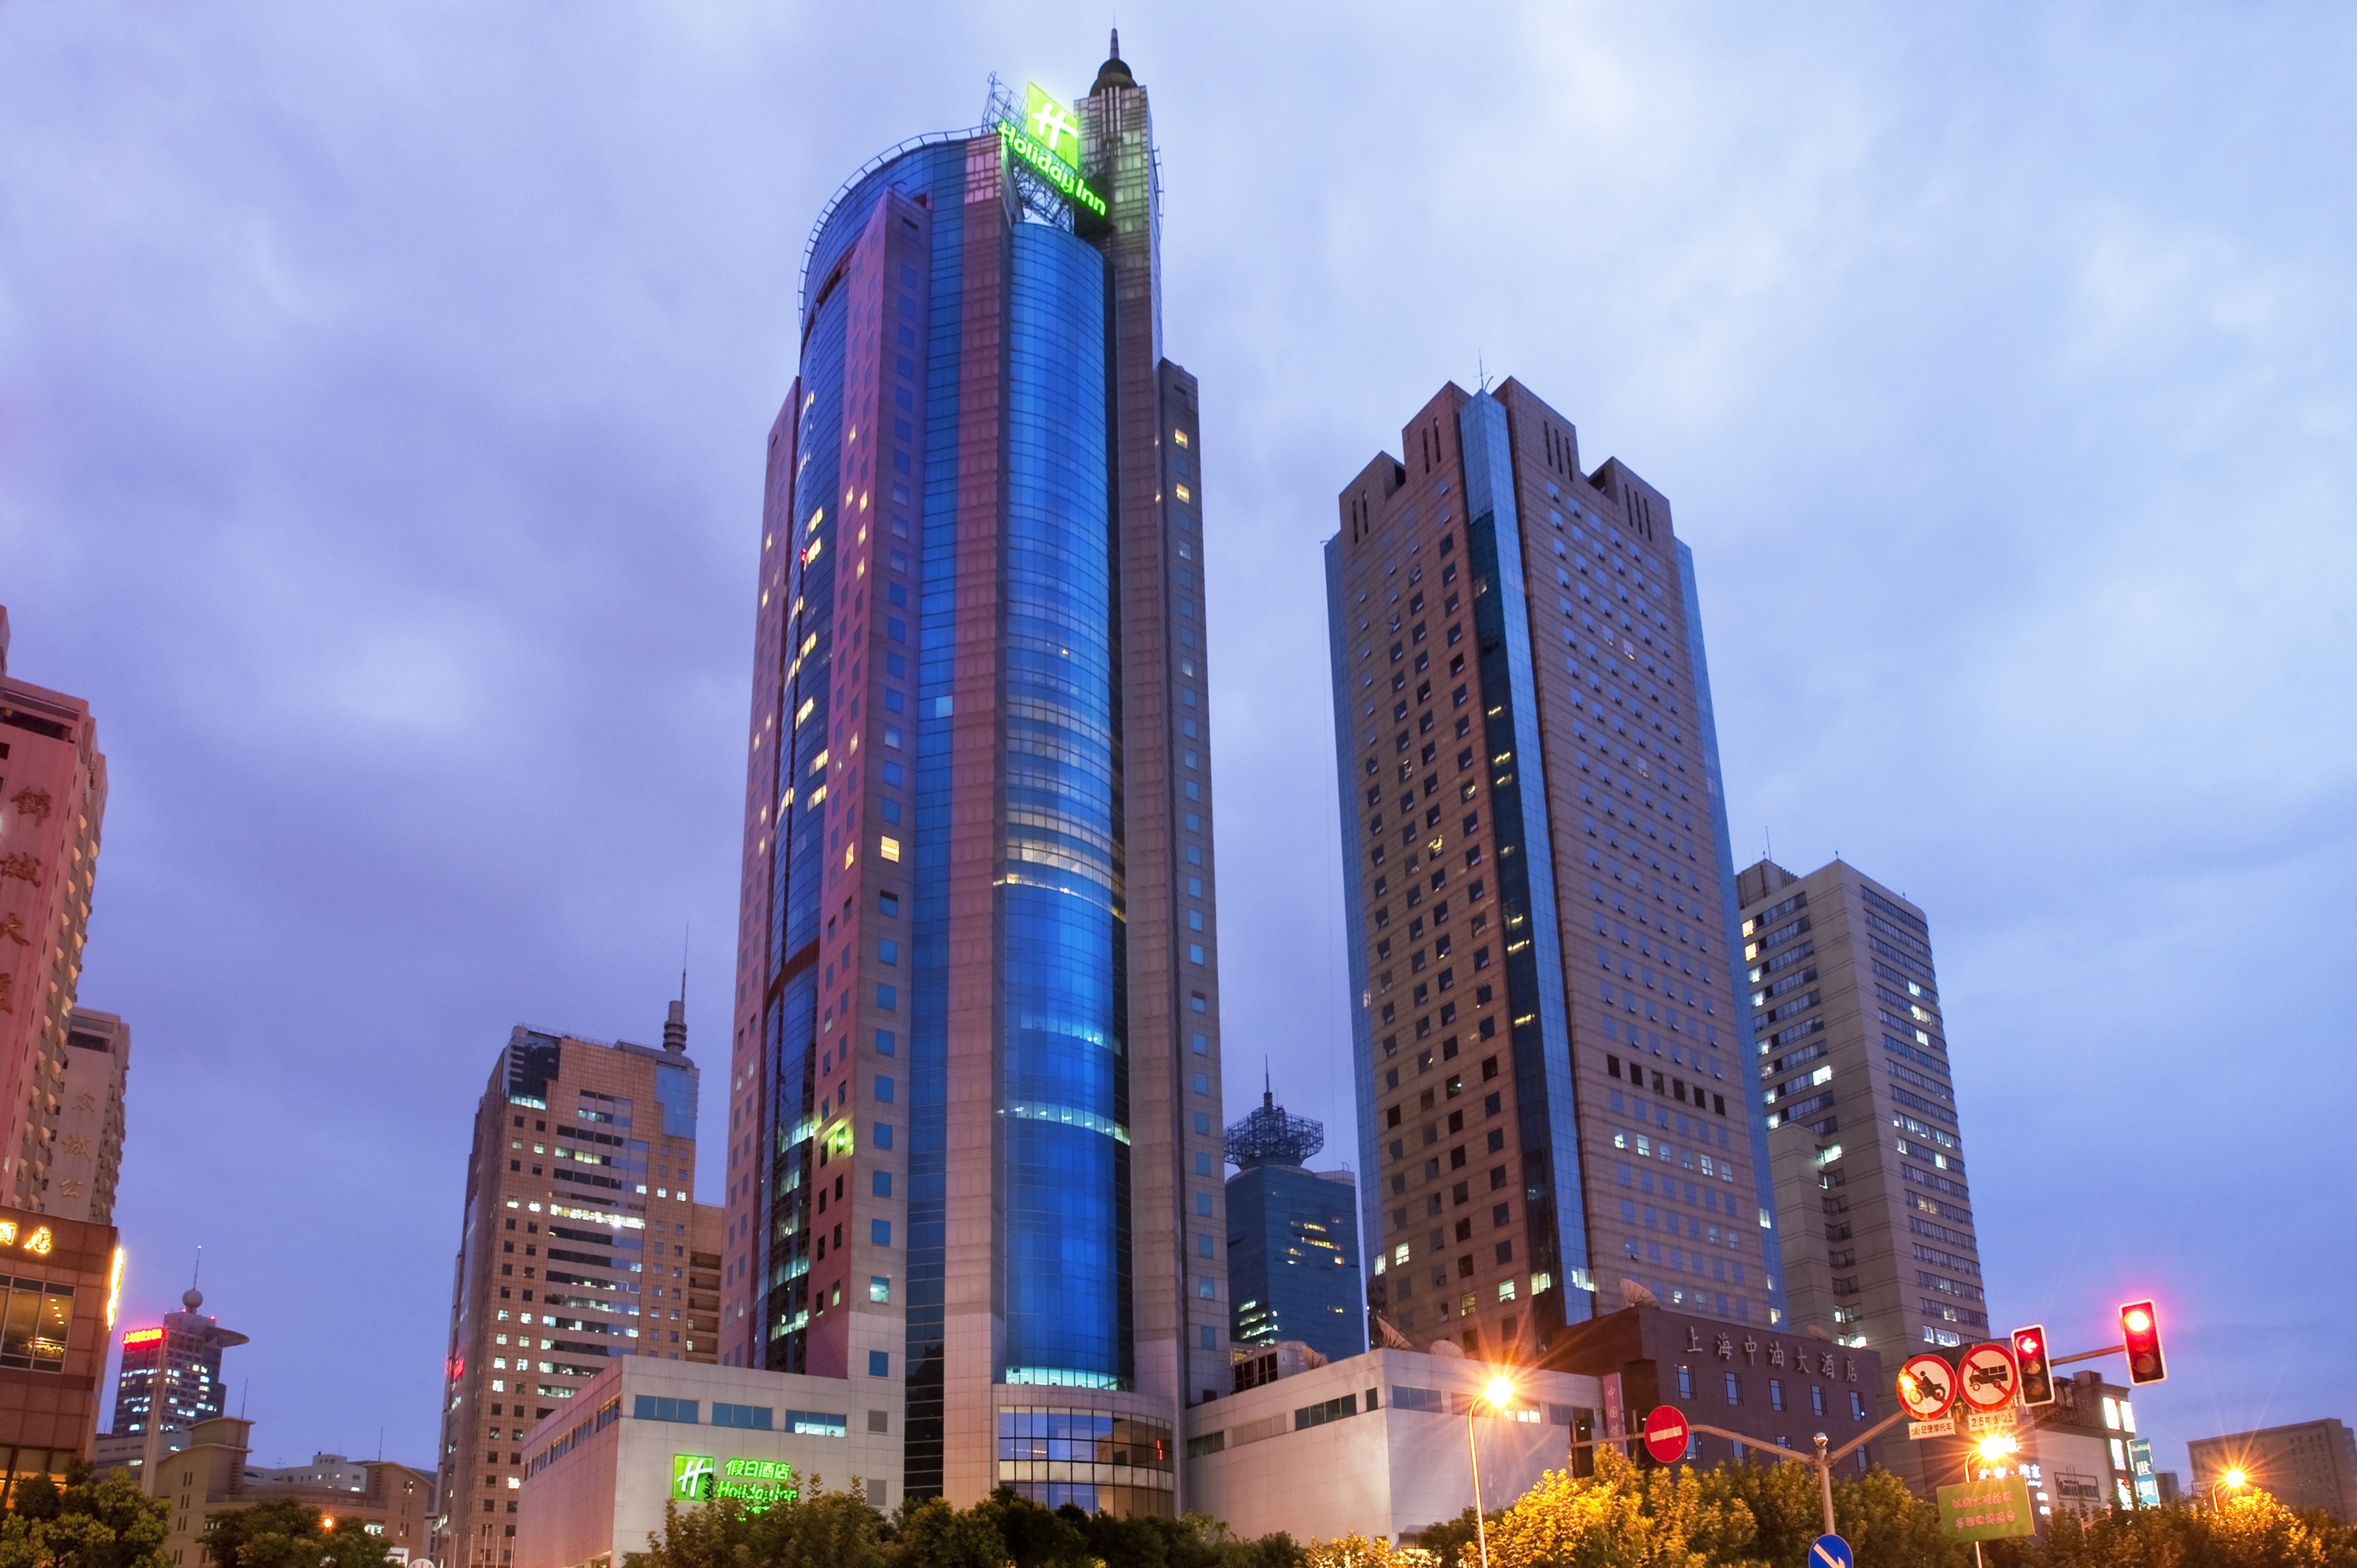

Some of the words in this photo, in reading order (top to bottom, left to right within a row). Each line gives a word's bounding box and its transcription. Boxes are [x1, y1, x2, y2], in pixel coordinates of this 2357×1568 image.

[997, 119, 1075, 194] Holiday
[1075, 177, 1107, 216] Inn
[1686, 1325, 1857, 1383] 上海中油大酒店
[725, 1459, 791, 1481] 假日酒店
